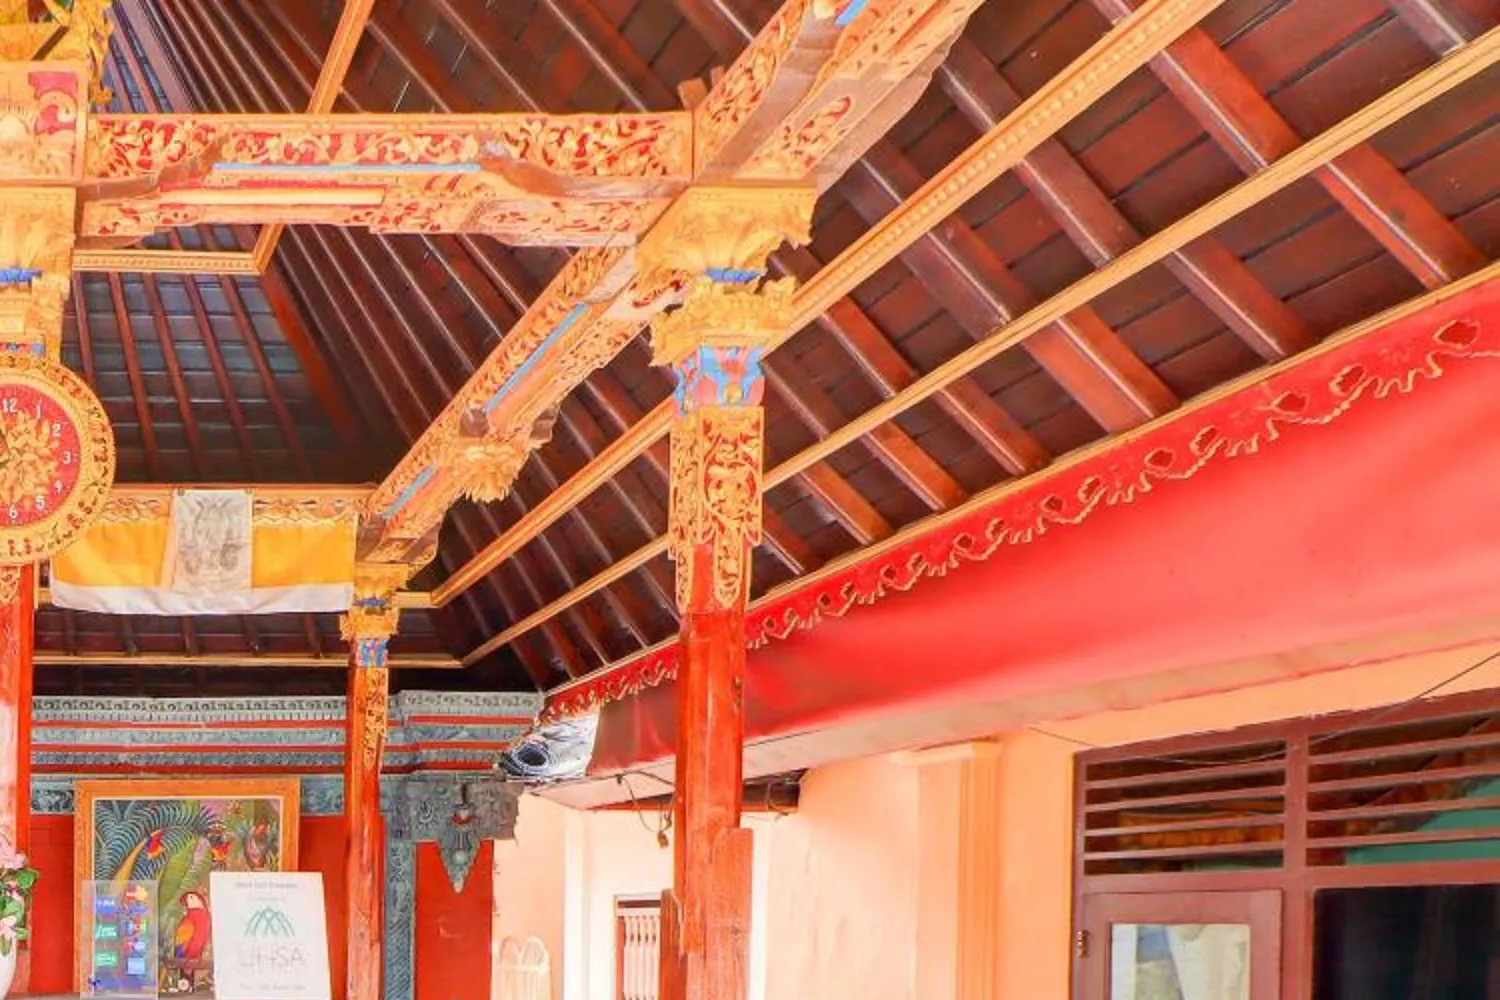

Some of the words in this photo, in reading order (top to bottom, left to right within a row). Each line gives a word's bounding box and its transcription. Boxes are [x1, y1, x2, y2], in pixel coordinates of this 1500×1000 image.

[2, 398, 18, 413] 12
[36, 403, 43, 418] 1
[52, 423, 61, 438] 2
[62, 450, 71, 465] 3
[53, 480, 63, 494] 4
[35, 496, 45, 510] 5
[8, 504, 18, 519] 6
